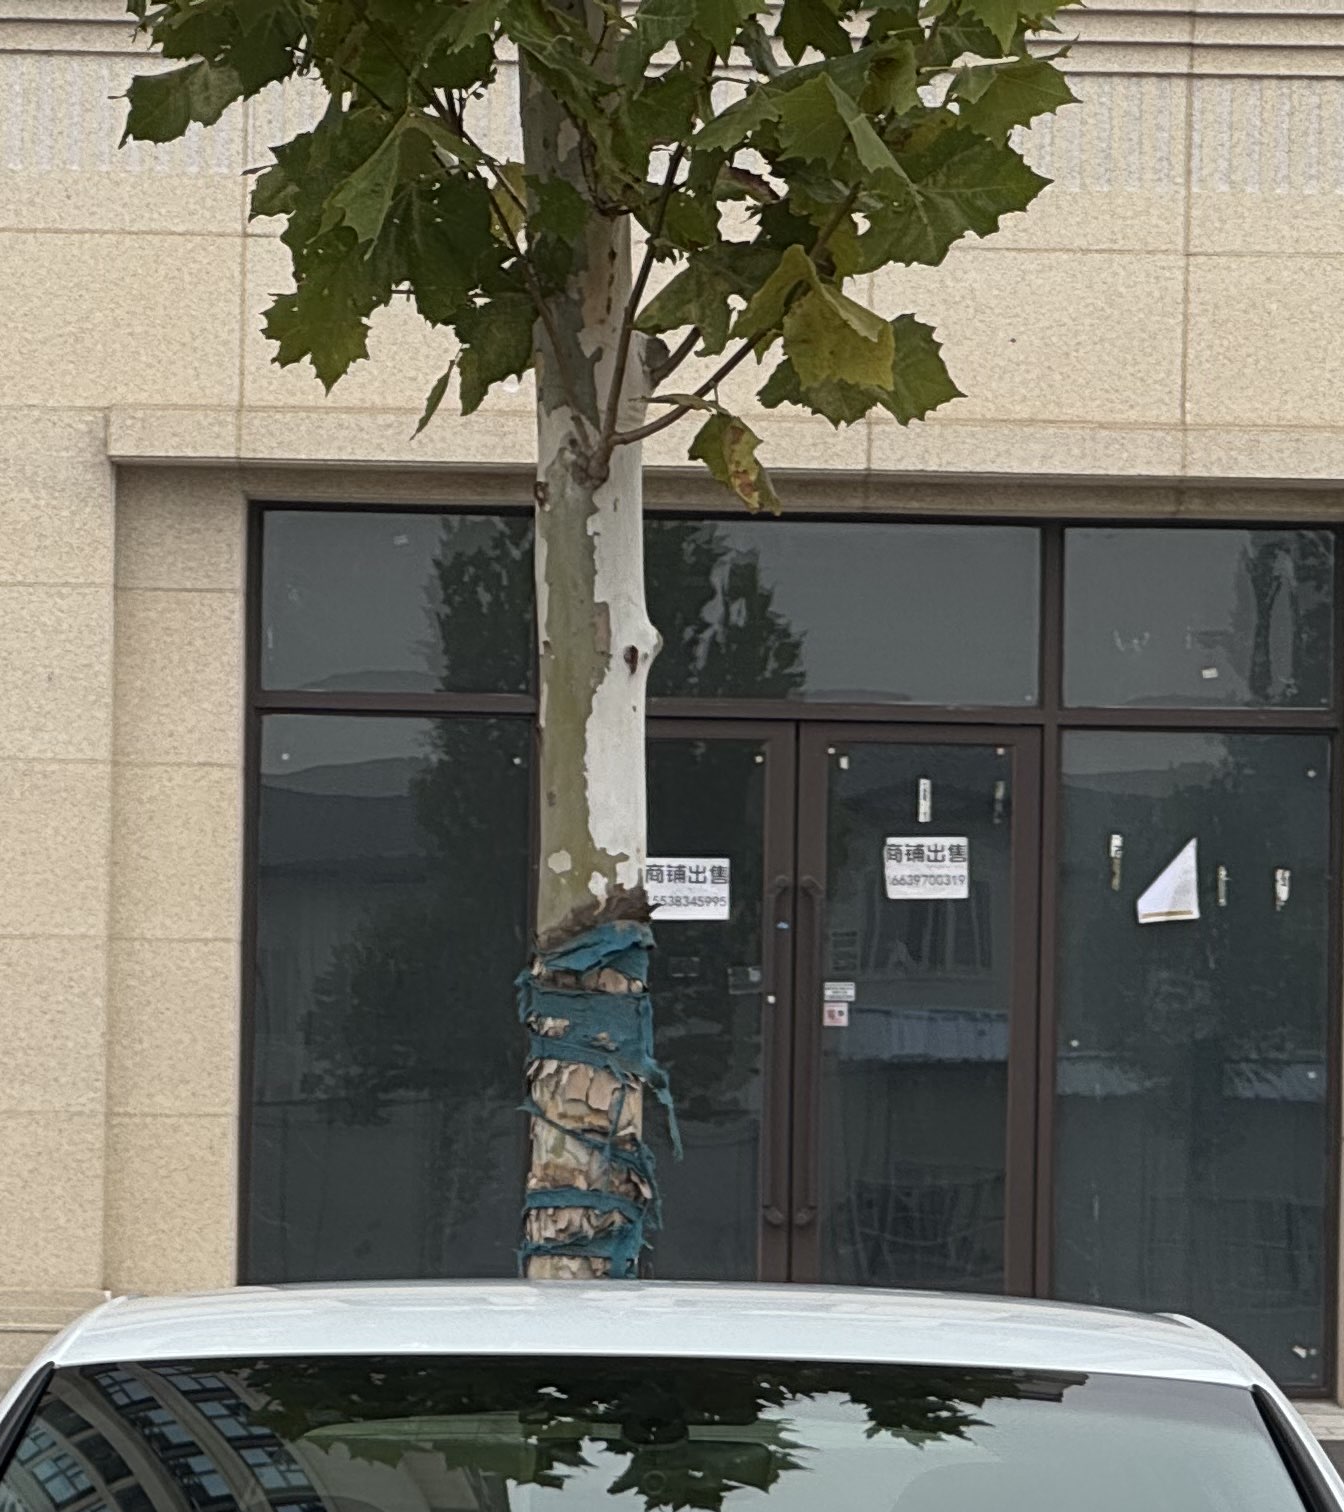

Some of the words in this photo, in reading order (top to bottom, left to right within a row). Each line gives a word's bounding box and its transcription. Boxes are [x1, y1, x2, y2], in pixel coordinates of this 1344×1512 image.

[886, 843, 967, 863] 商铺出售
[645, 864, 729, 884] 商铺出售
